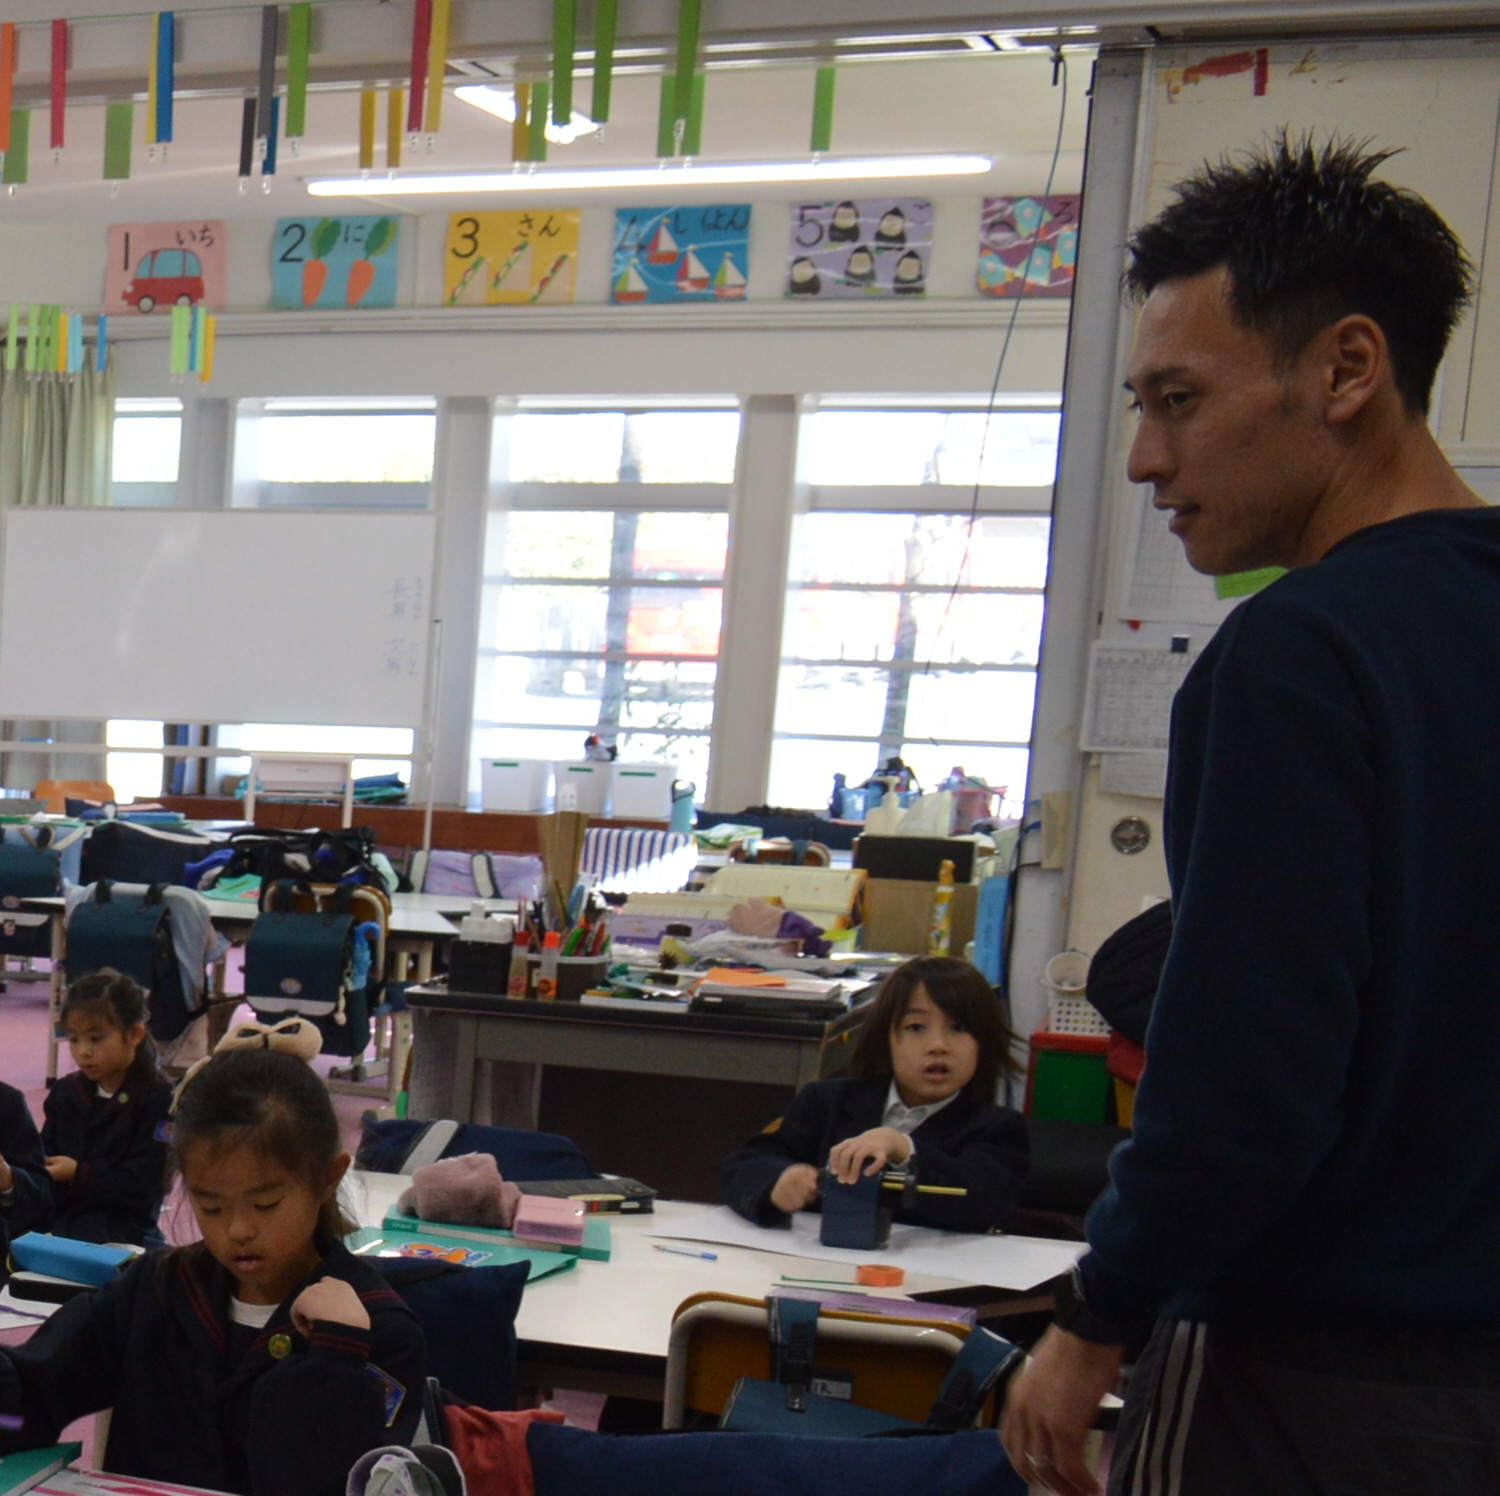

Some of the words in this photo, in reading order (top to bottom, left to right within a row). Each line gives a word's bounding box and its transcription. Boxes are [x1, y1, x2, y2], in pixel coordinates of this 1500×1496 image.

[175, 224, 216, 248] いち
[279, 223, 307, 263] 2
[343, 224, 365, 244] に
[451, 216, 480, 259] 3
[516, 213, 560, 239] さん
[618, 215, 647, 257] 4
[795, 205, 823, 248] 5
[122, 231, 130, 271] 1
